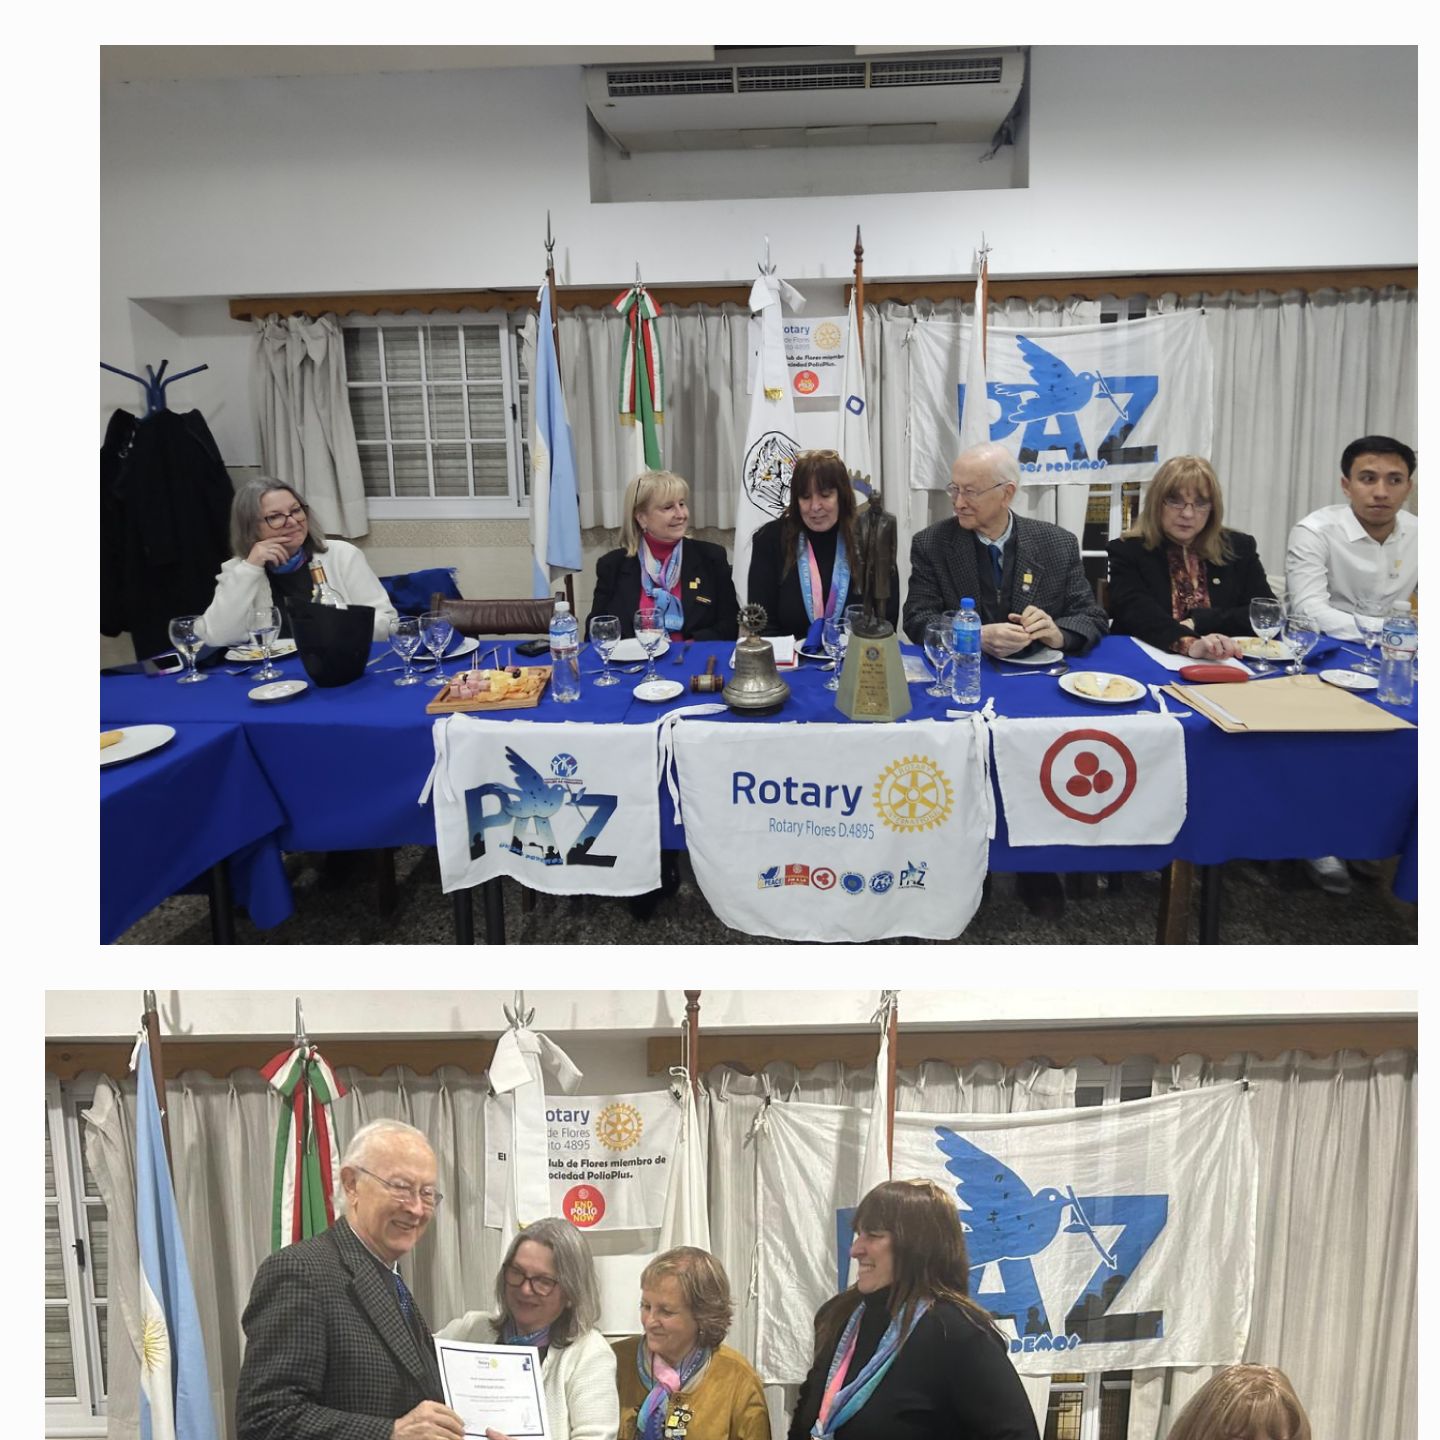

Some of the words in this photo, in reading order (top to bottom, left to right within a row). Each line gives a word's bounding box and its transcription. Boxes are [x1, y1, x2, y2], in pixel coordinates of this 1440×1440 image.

[783, 325, 811, 336] otary
[1045, 458, 1108, 474] PODEMOS
[732, 770, 864, 817] Rotary
[464, 782, 619, 868] PAZ
[768, 816, 804, 838] Rotary
[805, 820, 837, 838] Flores
[838, 822, 875, 841] D.4895
[545, 1107, 591, 1125] otary
[561, 1127, 591, 1138] Flores
[563, 1139, 591, 1151] 4895
[548, 1158, 564, 1169] lub
[566, 1158, 578, 1169] de
[580, 1158, 608, 1169] Flores
[610, 1156, 653, 1168] miembro
[654, 1155, 667, 1165] de
[548, 1170, 585, 1181] ociedad
[587, 1170, 634, 1181] PolioPlus.
[574, 1199, 593, 1208] END
[570, 1206, 598, 1216] POLIO
[573, 1214, 595, 1222] NOW
[1008, 1332, 1081, 1354] DEMOS
